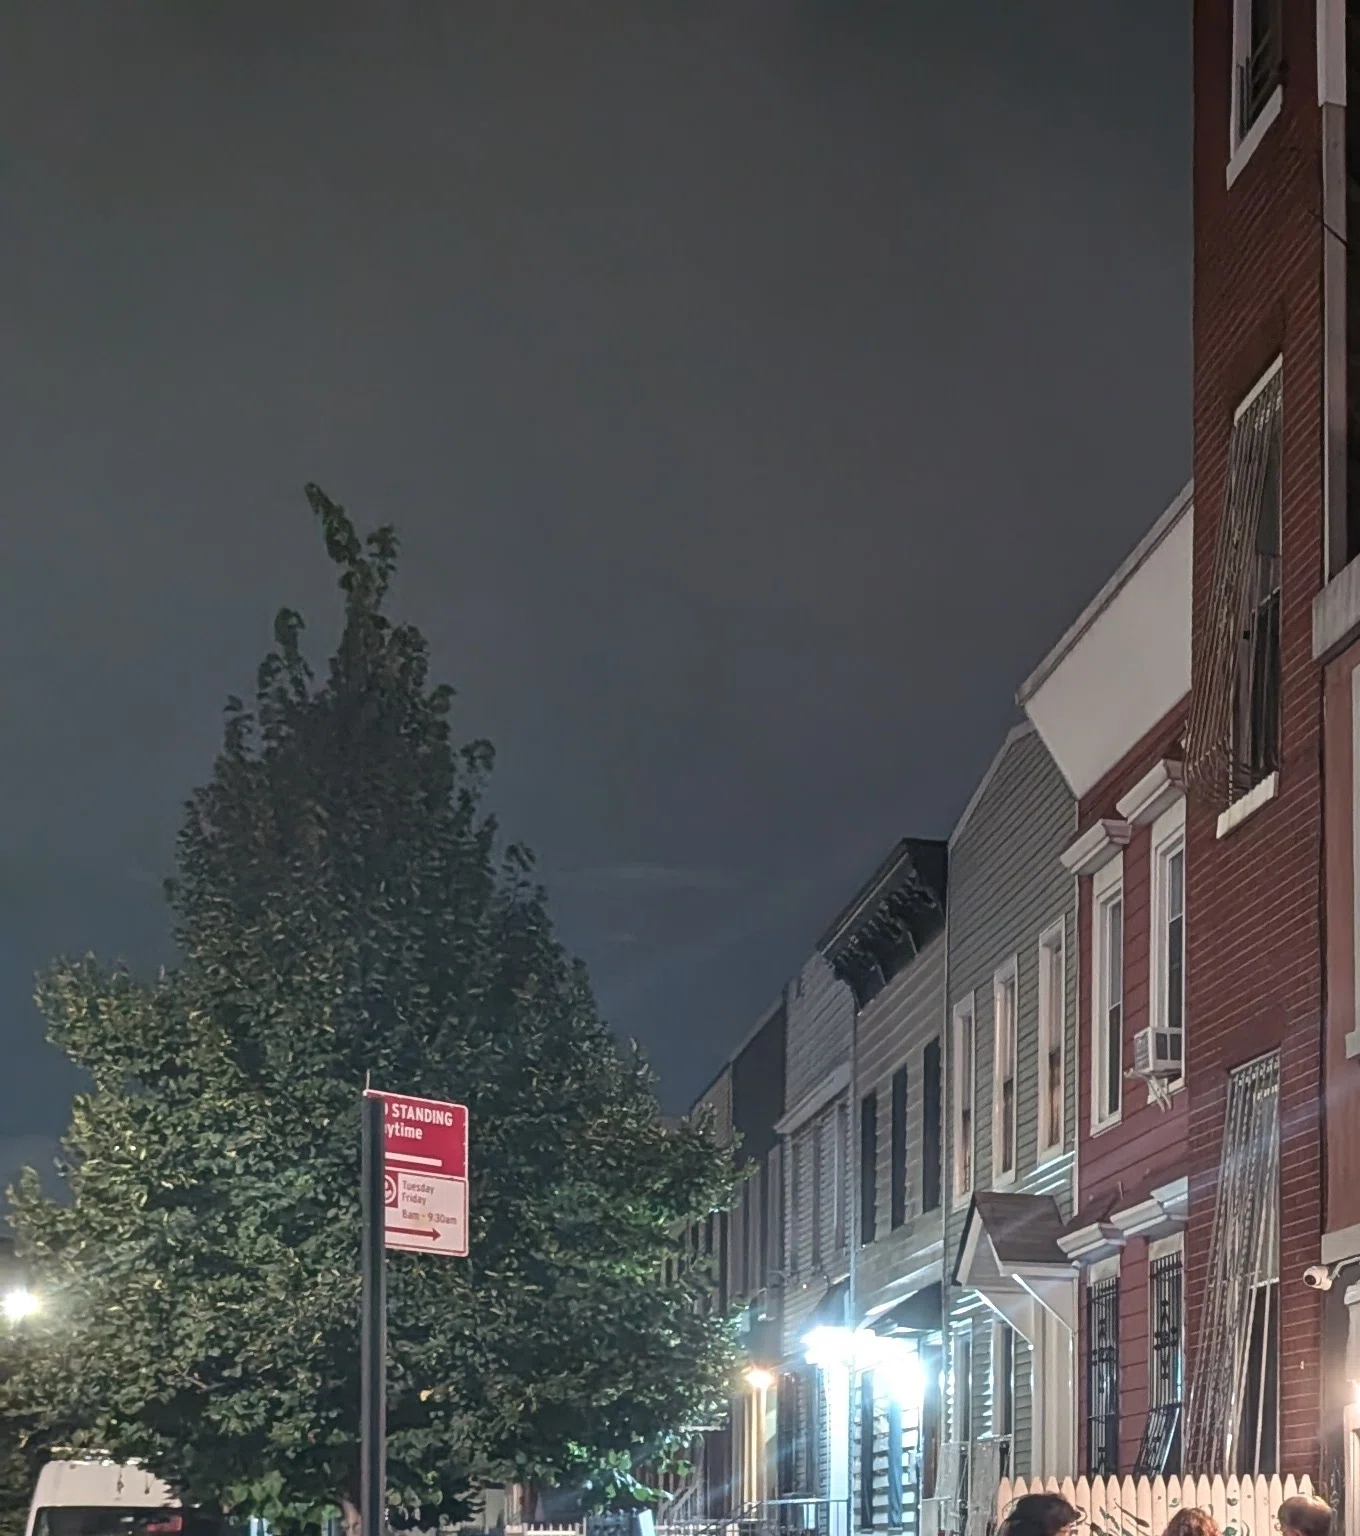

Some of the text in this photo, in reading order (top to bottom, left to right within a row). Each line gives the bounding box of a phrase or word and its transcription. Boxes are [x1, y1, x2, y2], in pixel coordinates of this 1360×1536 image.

[391, 1102, 453, 1127] STANDING
[385, 1122, 423, 1141] ytime
[402, 1179, 435, 1195] Tuesday
[401, 1191, 427, 1206] Friday
[402, 1208, 420, 1221] 8am
